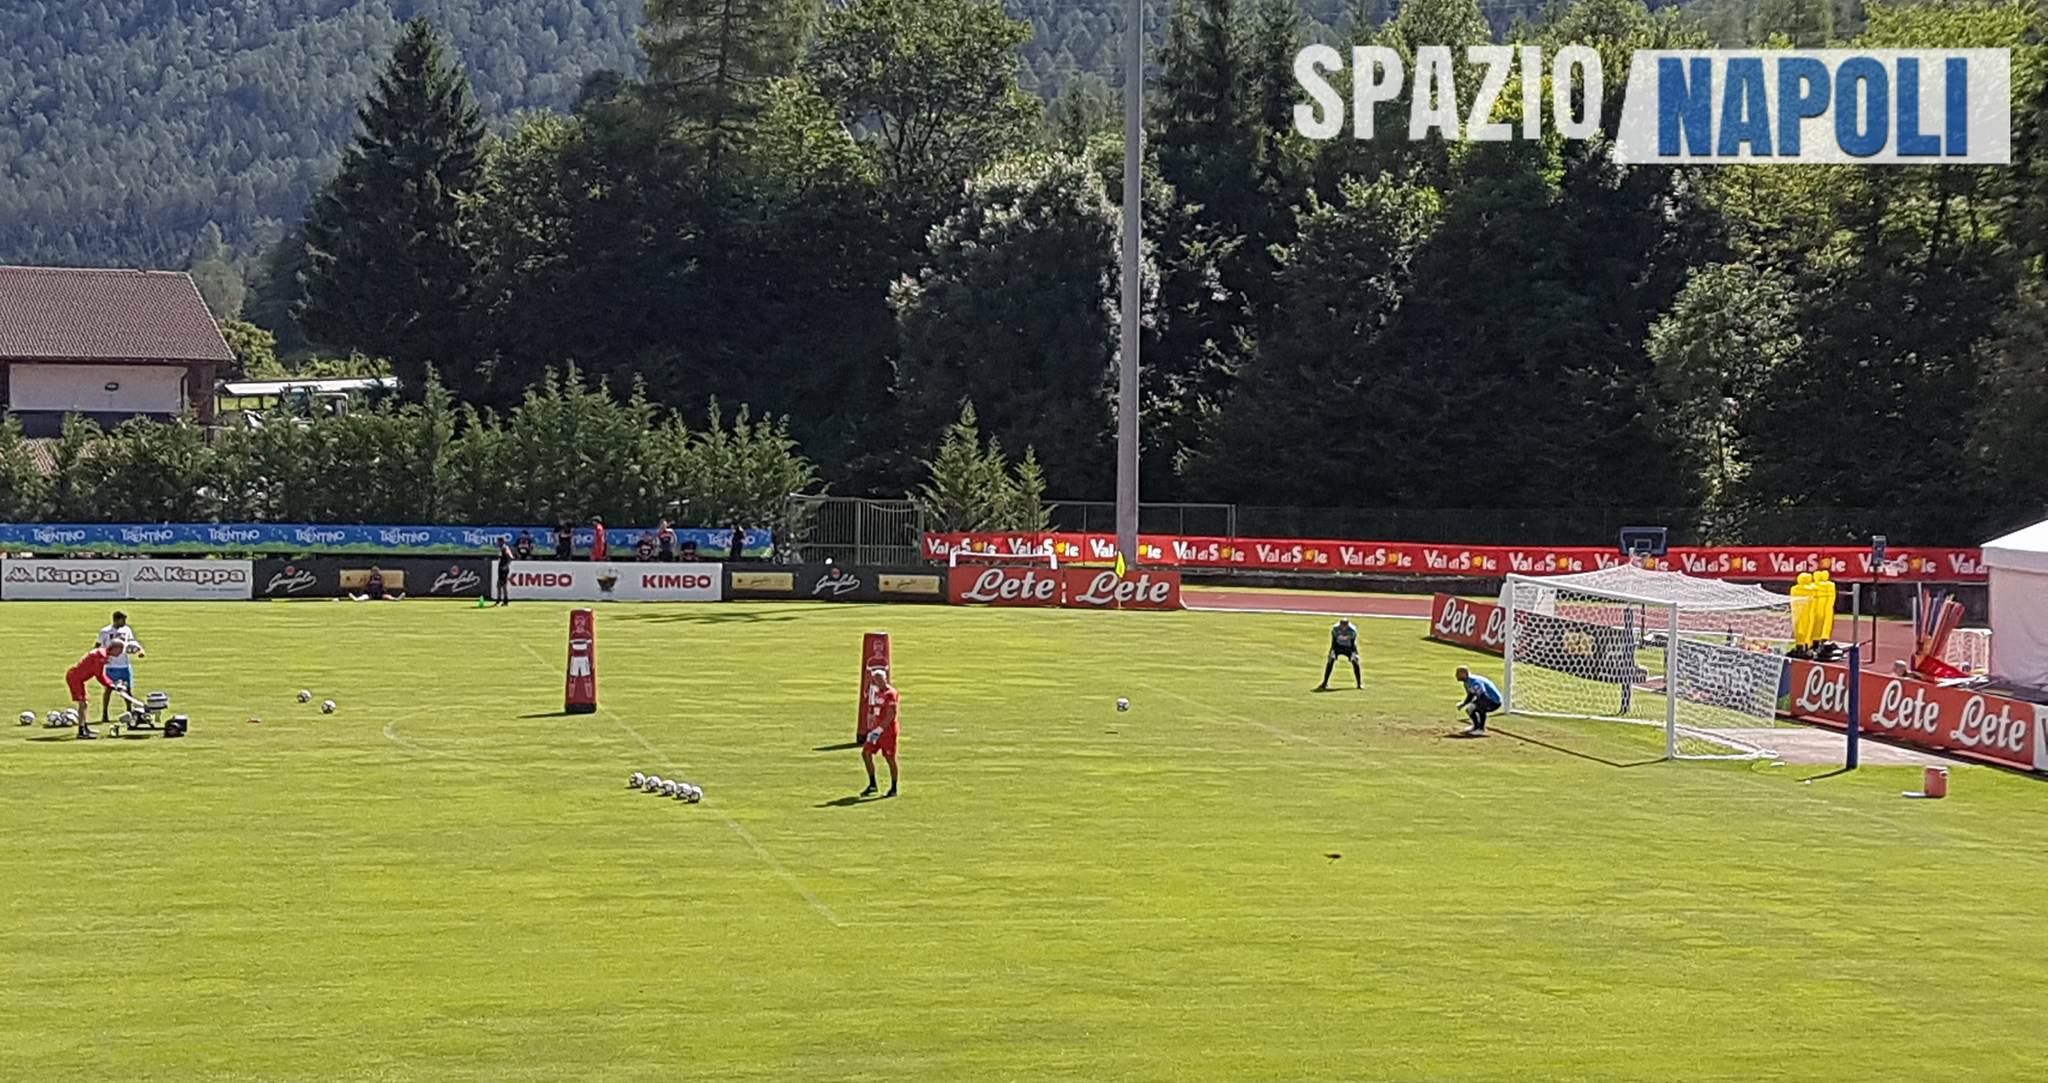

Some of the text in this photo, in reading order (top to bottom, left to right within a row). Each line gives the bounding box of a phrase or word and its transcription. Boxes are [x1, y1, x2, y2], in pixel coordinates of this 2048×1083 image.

[32, 527, 86, 542] TRENTINO
[120, 526, 174, 542] TRENTINO
[208, 527, 260, 542] TRENTINO
[294, 527, 346, 542] TRENTINO
[380, 528, 430, 544] TRENTINO
[927, 538, 949, 554] Val
[1008, 538, 1031, 554] Val
[1090, 539, 1114, 558] Val
[1172, 541, 1196, 559] Val
[1256, 544, 1280, 562] Val
[1340, 546, 1363, 565] Val
[1423, 550, 1446, 568] Val
[1509, 552, 1532, 571] Val
[1681, 553, 1706, 572] Val
[1769, 553, 1794, 572] Val
[1948, 554, 1975, 573] Val
[36, 566, 119, 585] Kappa
[165, 566, 246, 585] Kappa
[506, 573, 711, 589] KIMBO KIMBO
[961, 568, 1056, 600] Lete
[1075, 570, 1171, 604] Lete
[1435, 597, 1476, 637] Lete
[1796, 665, 1850, 712] Let
[1872, 679, 1939, 733] Lete
[1950, 695, 2026, 752] Lete
